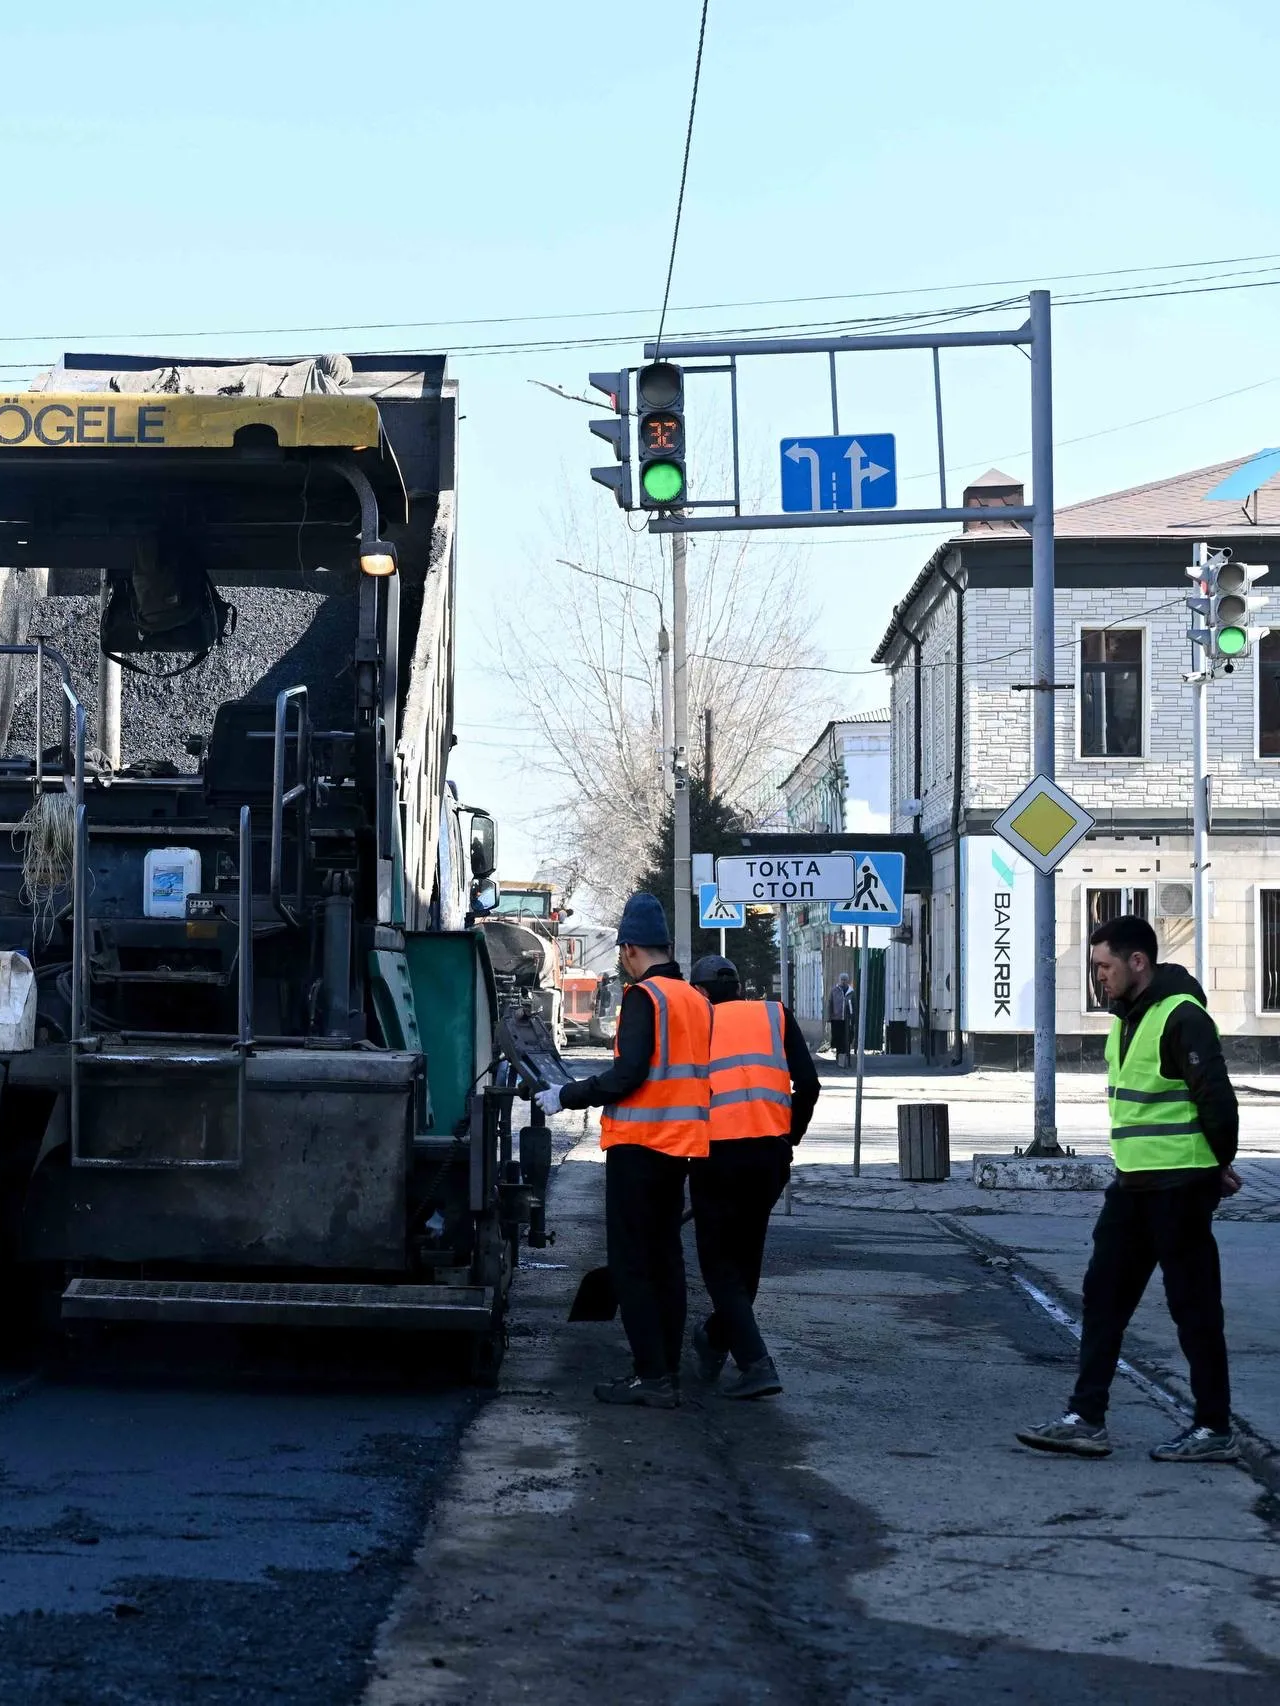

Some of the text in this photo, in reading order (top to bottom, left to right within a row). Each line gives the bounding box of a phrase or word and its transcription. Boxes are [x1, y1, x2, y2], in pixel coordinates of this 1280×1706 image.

[648, 422, 677, 449] 32
[746, 860, 821, 880] ТОҚТА
[752, 881, 814, 898] СТОП
